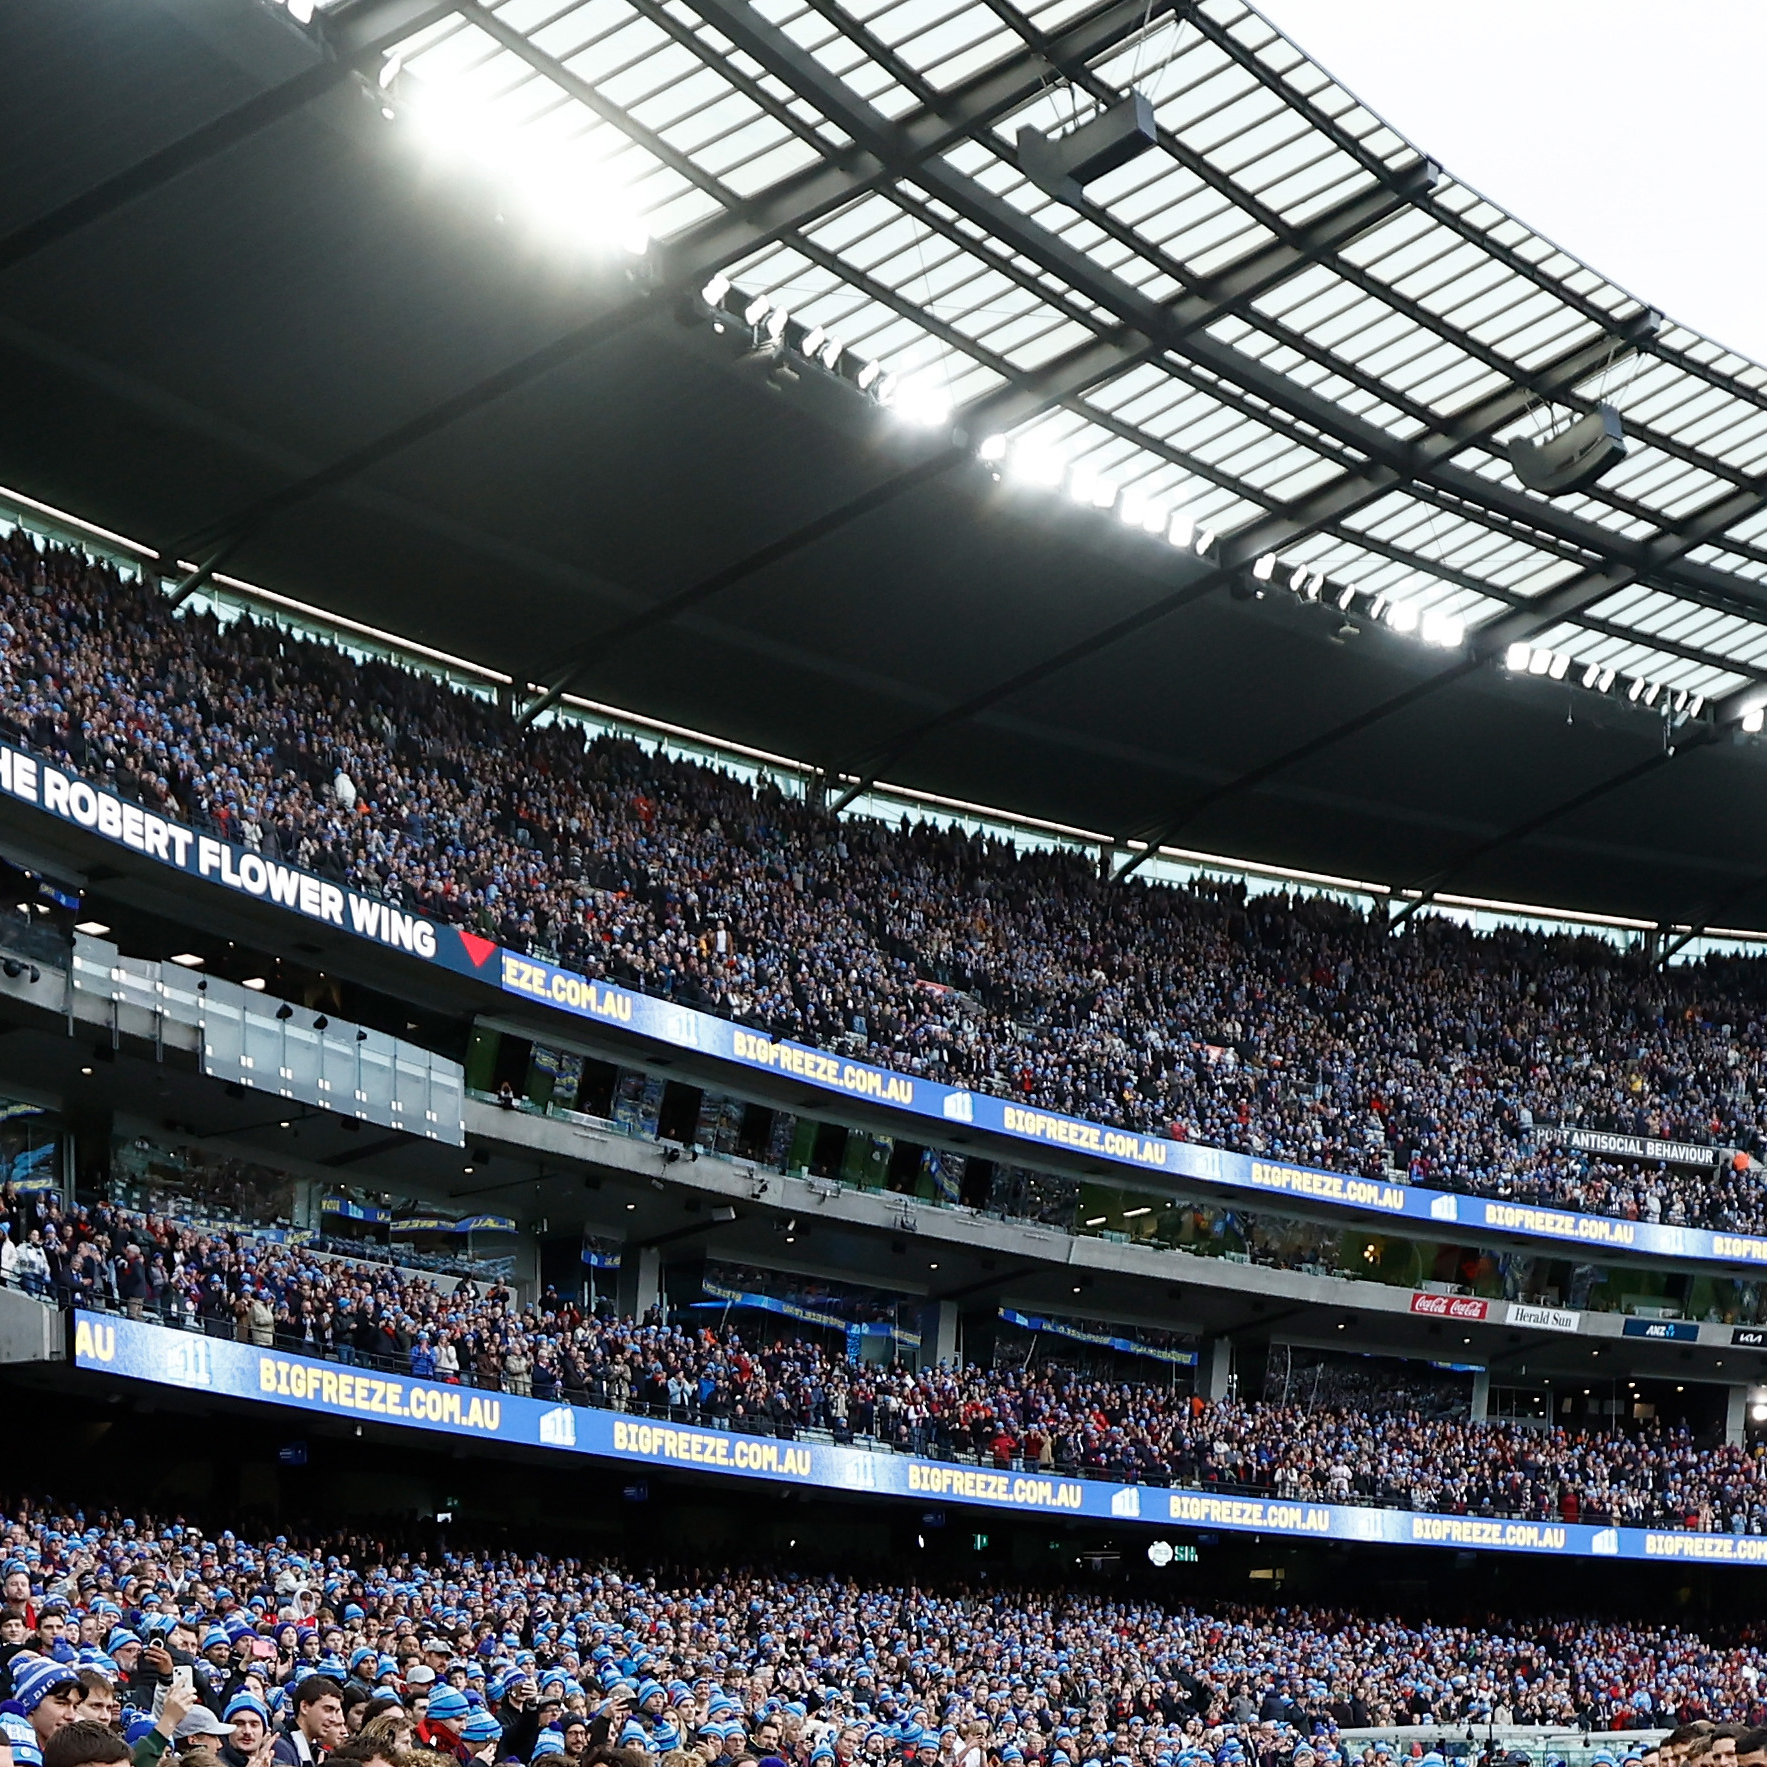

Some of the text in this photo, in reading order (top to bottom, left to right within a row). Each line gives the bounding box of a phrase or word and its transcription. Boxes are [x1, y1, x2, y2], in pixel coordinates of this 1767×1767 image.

[43, 766, 194, 868] ROBERT
[197, 834, 345, 927] FLOWER
[349, 891, 436, 959] WING
[502, 954, 631, 1021] EZE.COM.AU
[734, 1030, 912, 1105] BIGFREEZE.COM.AU
[1003, 1107, 1166, 1165] BIGFREEZE.COM.AU
[1571, 1131, 1645, 1155] ANTISOCIAL
[1646, 1142, 1714, 1165] BEHAVIOUR
[1251, 1161, 1405, 1209] BIGFREEZE.COM.AU
[1485, 1204, 1635, 1244] BIGFREEZE.COM.AU
[1513, 1307, 1572, 1328] Herald Sun
[1646, 1324, 1666, 1337] ANZ
[259, 1357, 500, 1431] BIGFREEZE.COM.AU
[613, 1421, 812, 1477] BIGFREEZE.COM.AU
[908, 1464, 1082, 1510] BIGFREEZE.COM.AU
[1169, 1495, 1331, 1532] BIGFREEZE.COM.AU
[1412, 1518, 1565, 1549] BIGFREEZE.COM.AU
